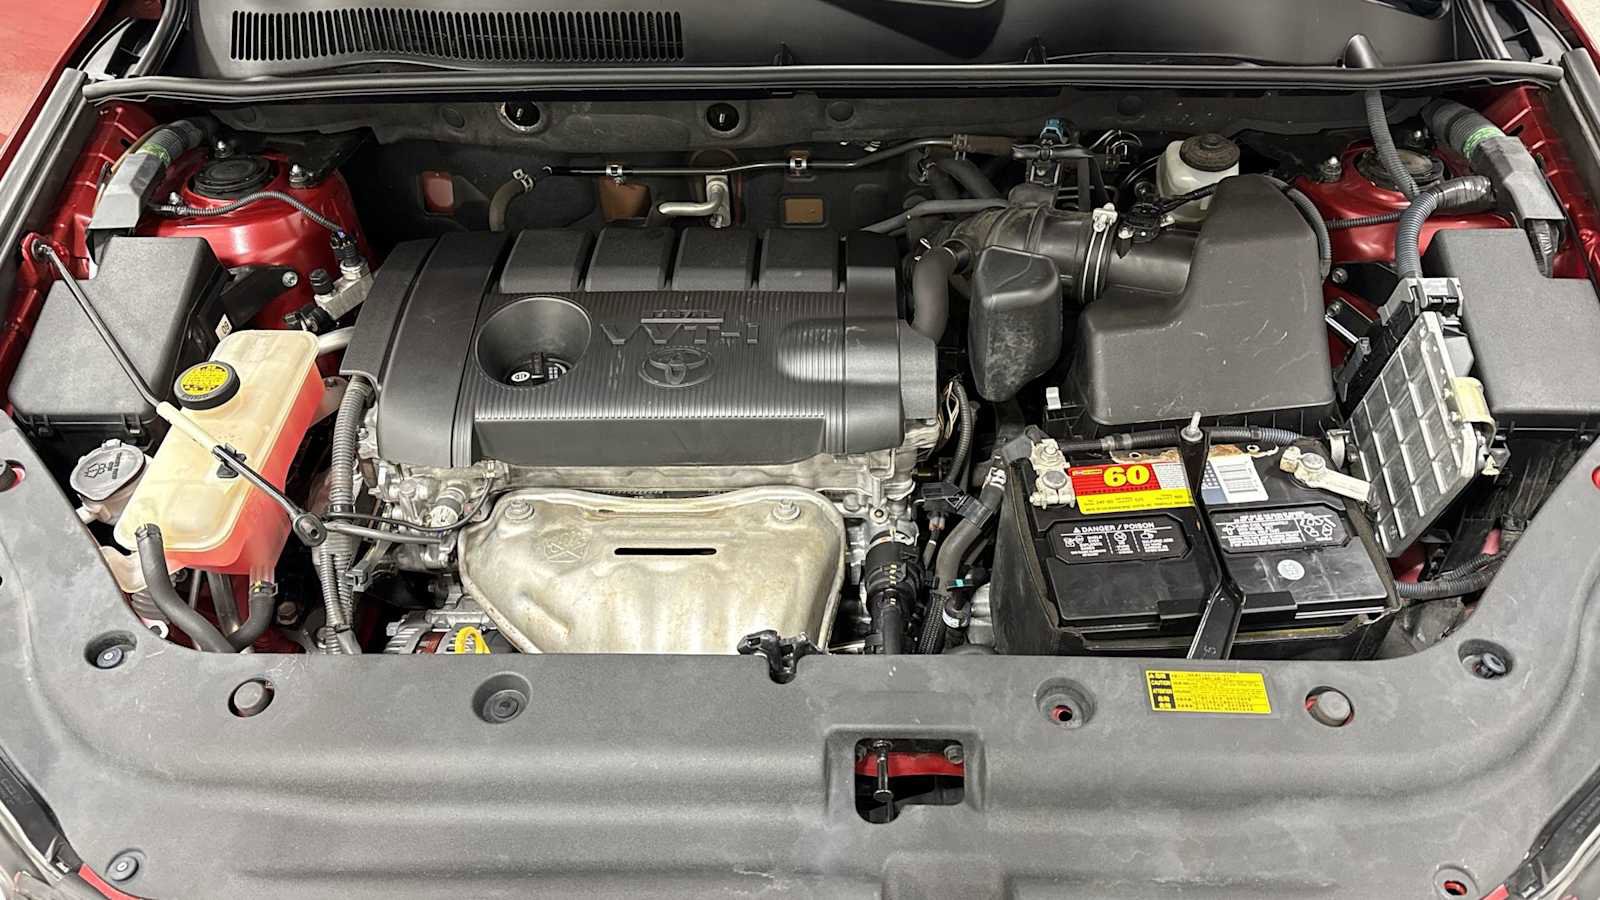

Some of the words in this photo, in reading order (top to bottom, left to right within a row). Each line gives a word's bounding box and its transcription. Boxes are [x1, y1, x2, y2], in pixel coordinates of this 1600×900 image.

[1103, 464, 1151, 487] 60
[1081, 525, 1115, 533] DANGER
[1123, 522, 1155, 531] POISON
